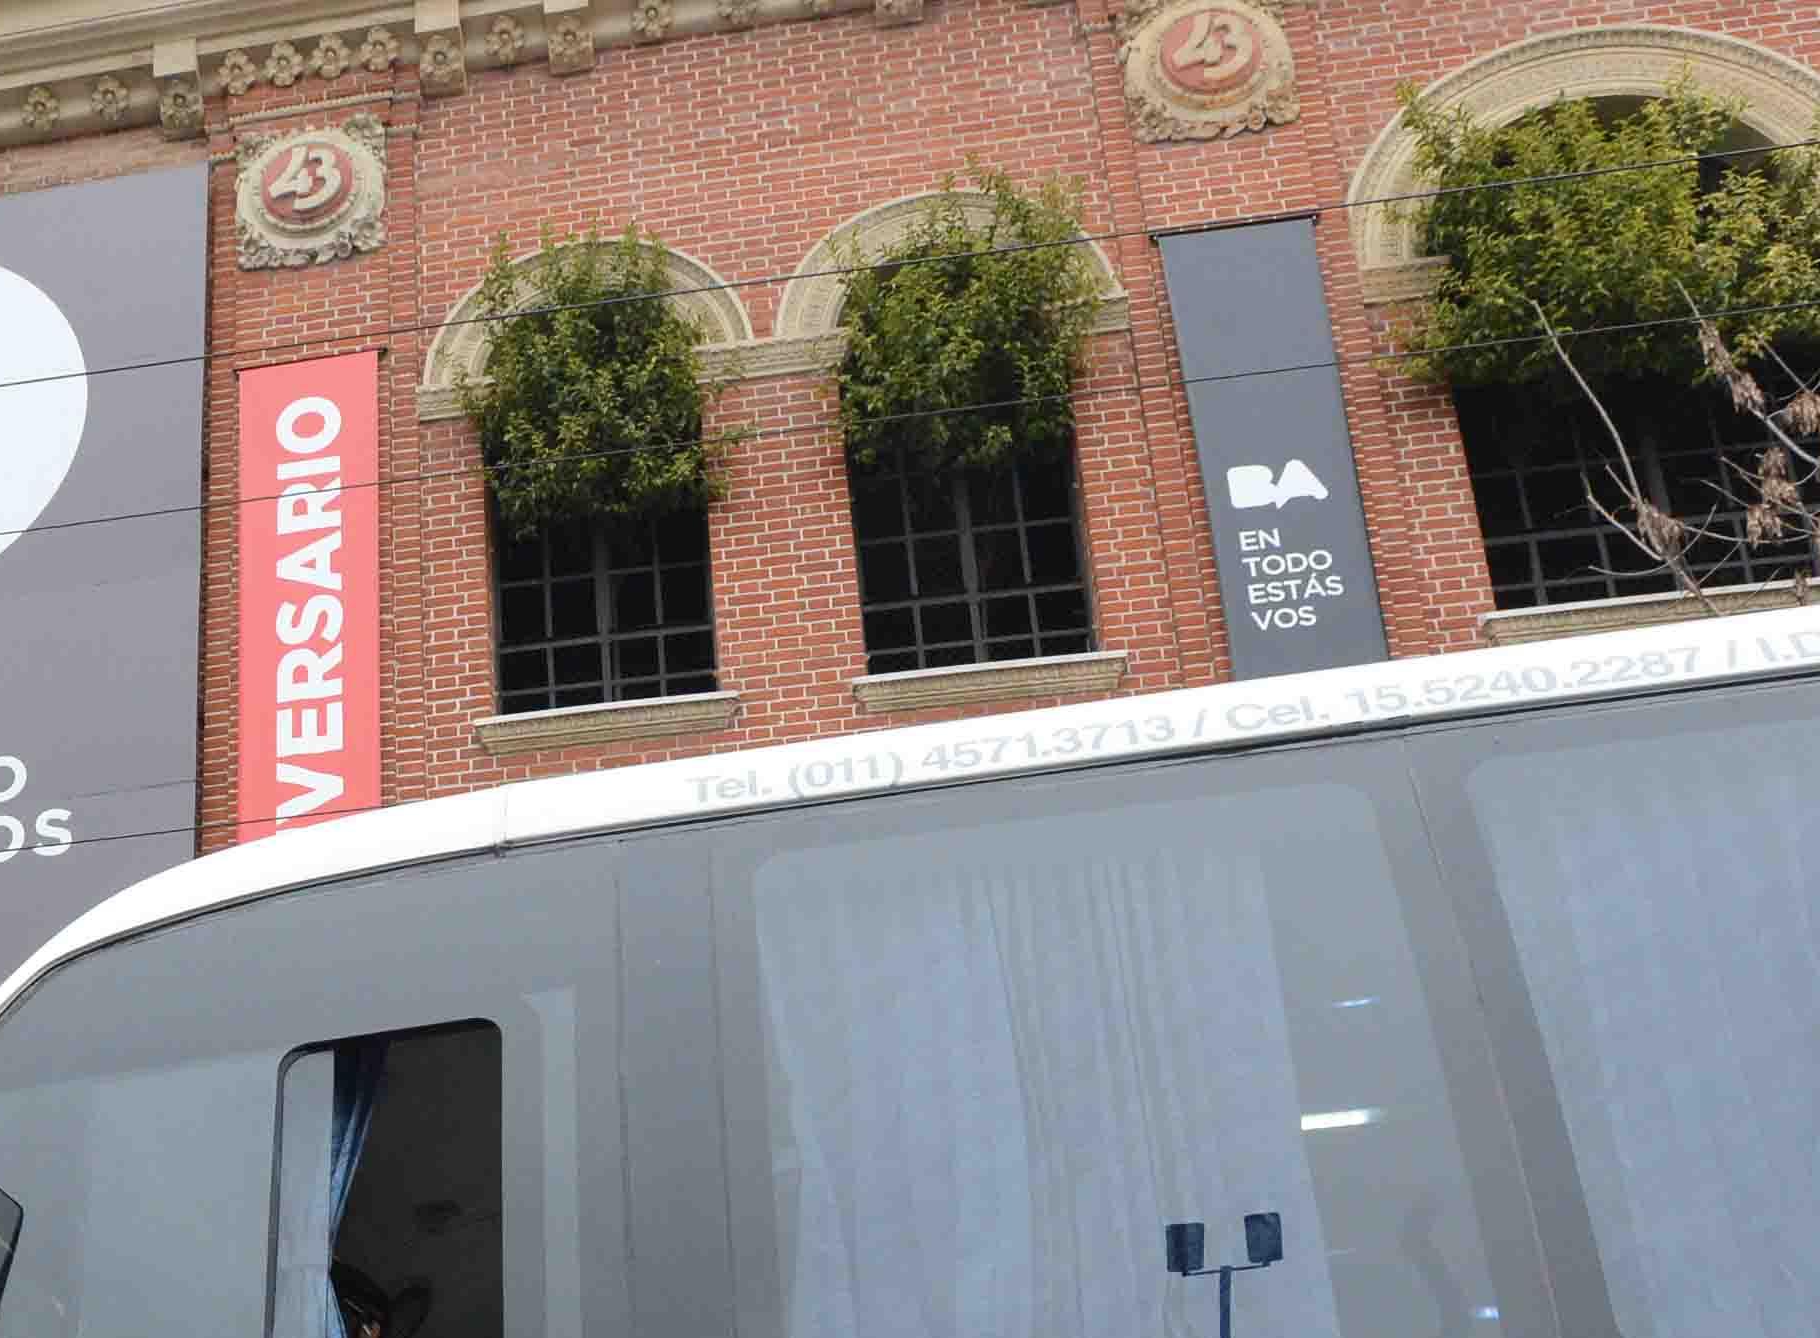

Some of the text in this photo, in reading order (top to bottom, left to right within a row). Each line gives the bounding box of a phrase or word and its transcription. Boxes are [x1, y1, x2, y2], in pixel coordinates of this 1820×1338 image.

[1238, 528, 1281, 551] EN
[1241, 550, 1332, 577] TODO
[1247, 573, 1344, 604] ESTÁS
[1251, 606, 1316, 631] VOS
[684, 773, 774, 804] Tel.
[788, 751, 904, 801] (011)
[921, 714, 1176, 774] 4571.3713
[1225, 696, 1330, 733] Cel.
[1341, 645, 1702, 714] 15.5240.2287
